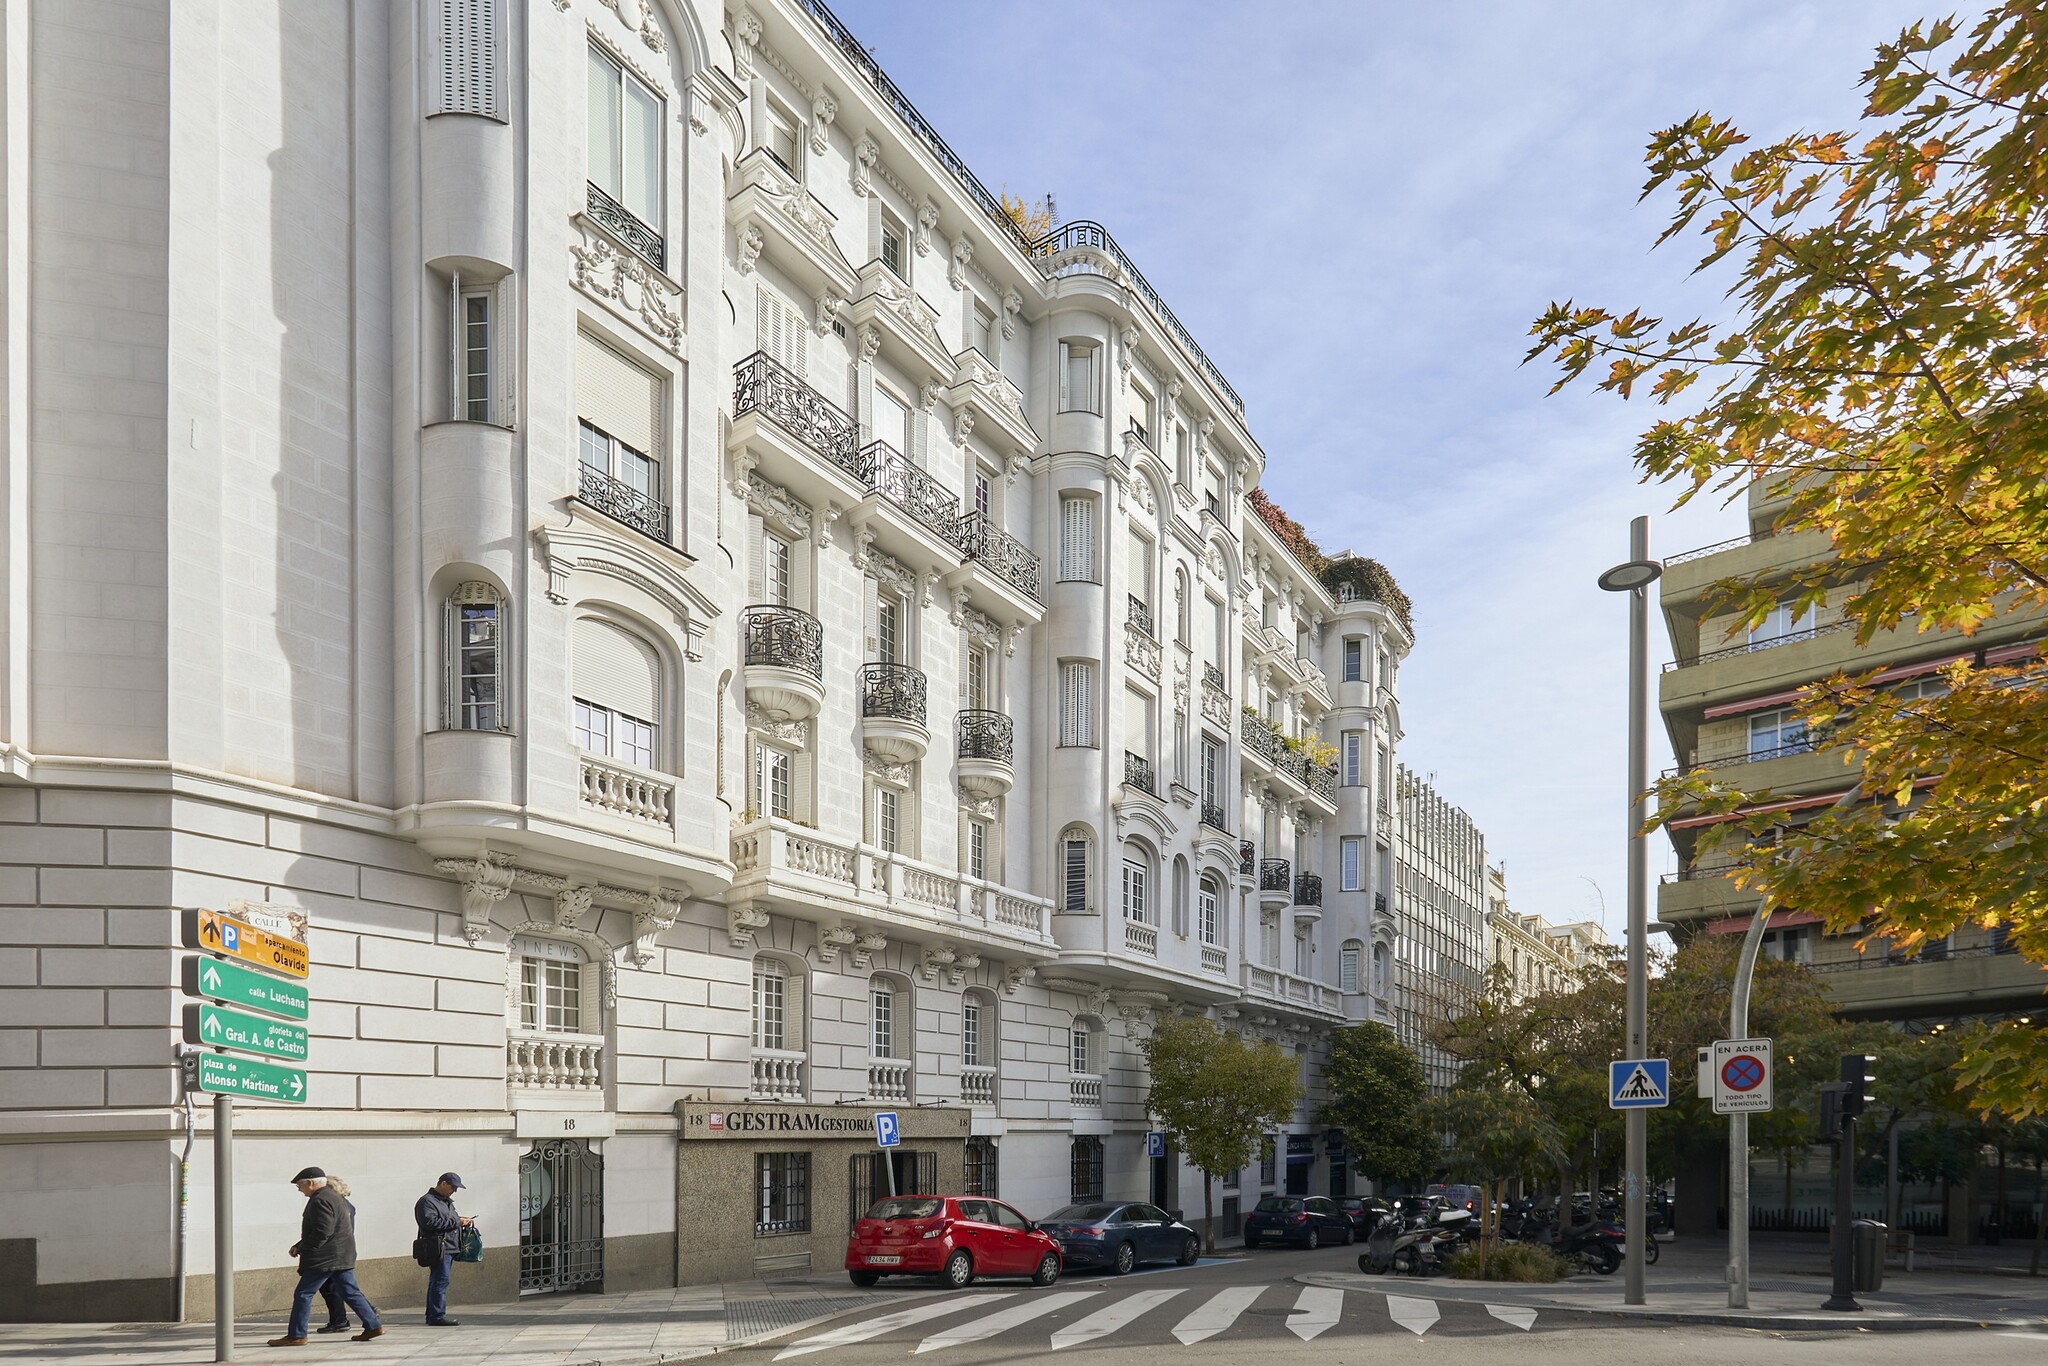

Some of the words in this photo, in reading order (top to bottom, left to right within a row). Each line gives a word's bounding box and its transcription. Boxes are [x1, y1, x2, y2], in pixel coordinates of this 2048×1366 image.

[254, 917, 282, 928] CALLE
[224, 926, 236, 946] P
[264, 937, 306, 958] aparcamiento
[273, 951, 306, 972] Olavide
[249, 987, 266, 999] calle
[270, 988, 305, 1009] Luchana
[225, 1027, 249, 1044] Gral.
[251, 1032, 261, 1046] A.
[264, 1037, 275, 1049] de
[277, 1038, 305, 1055] Castro
[268, 1025, 292, 1038] glorieta
[295, 1031, 304, 1040] del
[203, 1058, 224, 1070] plaza
[227, 1062, 237, 1072] de
[204, 1072, 238, 1088] Alonso
[564, 1118, 576, 1131] 18
[689, 1114, 703, 1126] 18
[726, 1111, 822, 1131] GESTRAM
[959, 1118, 968, 1127] 18
[879, 1117, 893, 1143] P
[1150, 1135, 1160, 1154] P
